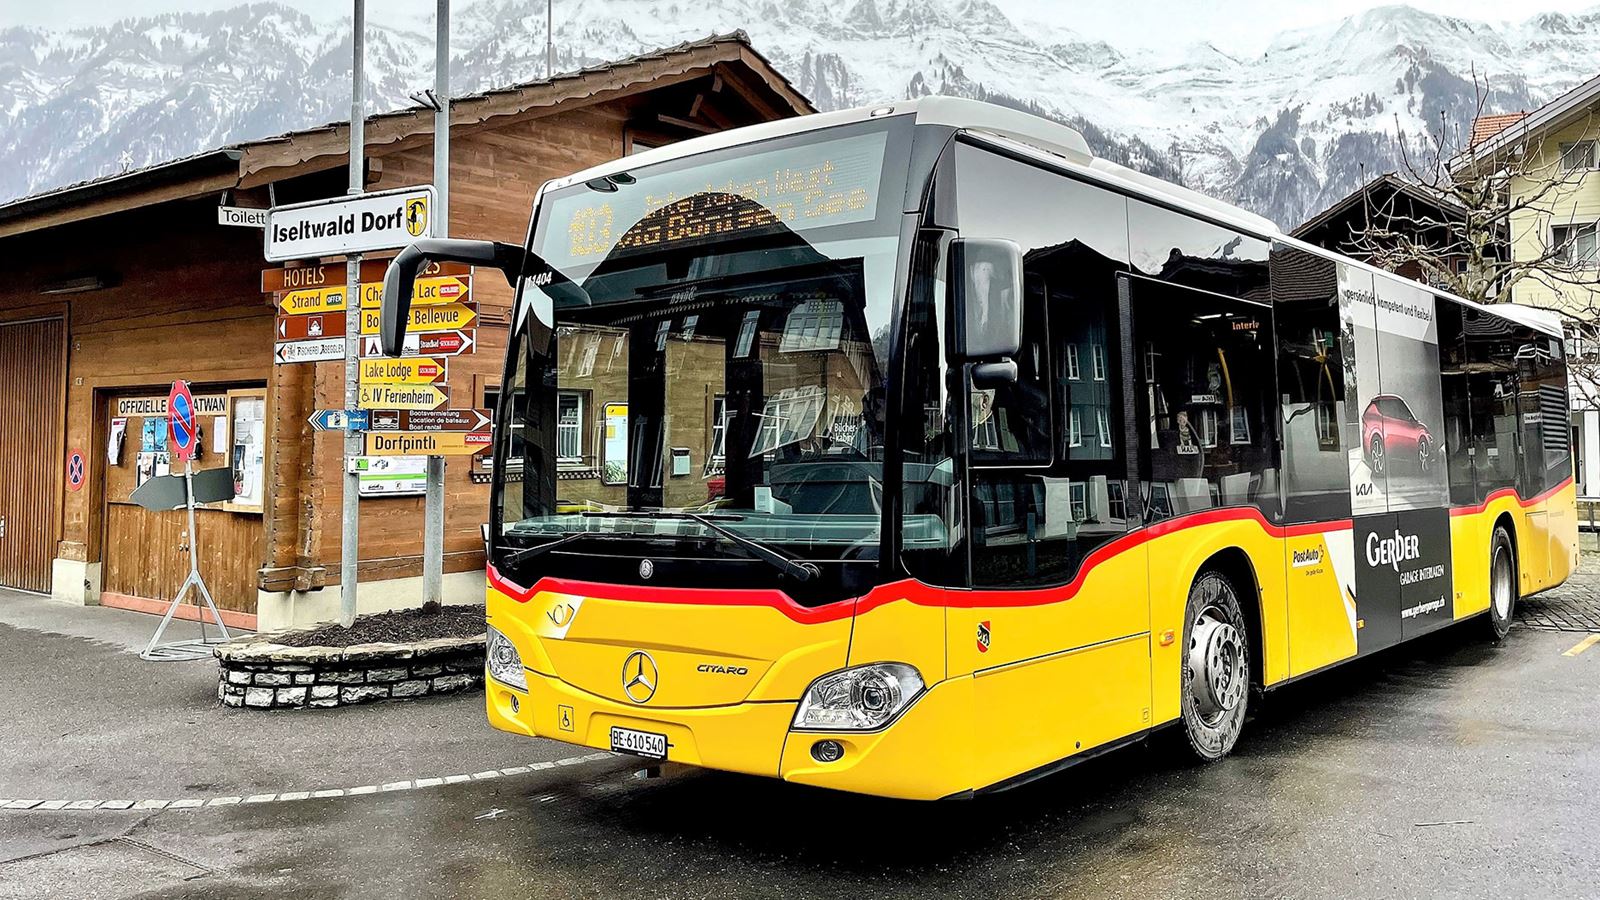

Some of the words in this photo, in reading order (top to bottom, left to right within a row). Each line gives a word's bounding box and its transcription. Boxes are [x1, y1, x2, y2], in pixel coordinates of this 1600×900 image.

[805, 188, 868, 218] See
[223, 209, 266, 225] Toilett
[273, 213, 355, 243] Iseltwald
[361, 207, 403, 231] Dorf
[283, 266, 325, 287] HOTELS
[418, 284, 437, 298] Lac
[291, 291, 321, 309] Strand
[414, 307, 459, 325] Bellevue
[365, 362, 384, 378] Lake
[386, 362, 412, 381] Lodge
[373, 388, 383, 402] IV
[385, 389, 434, 404] Ferienheim
[120, 399, 166, 413] OFFIZIELLE
[193, 397, 226, 412] ATWAN
[409, 410, 460, 418] Bootsvermietung
[1293, 549, 1319, 563] PostAuto
[1400, 569, 1419, 586] GARAGE
[697, 664, 748, 675] CITARO
